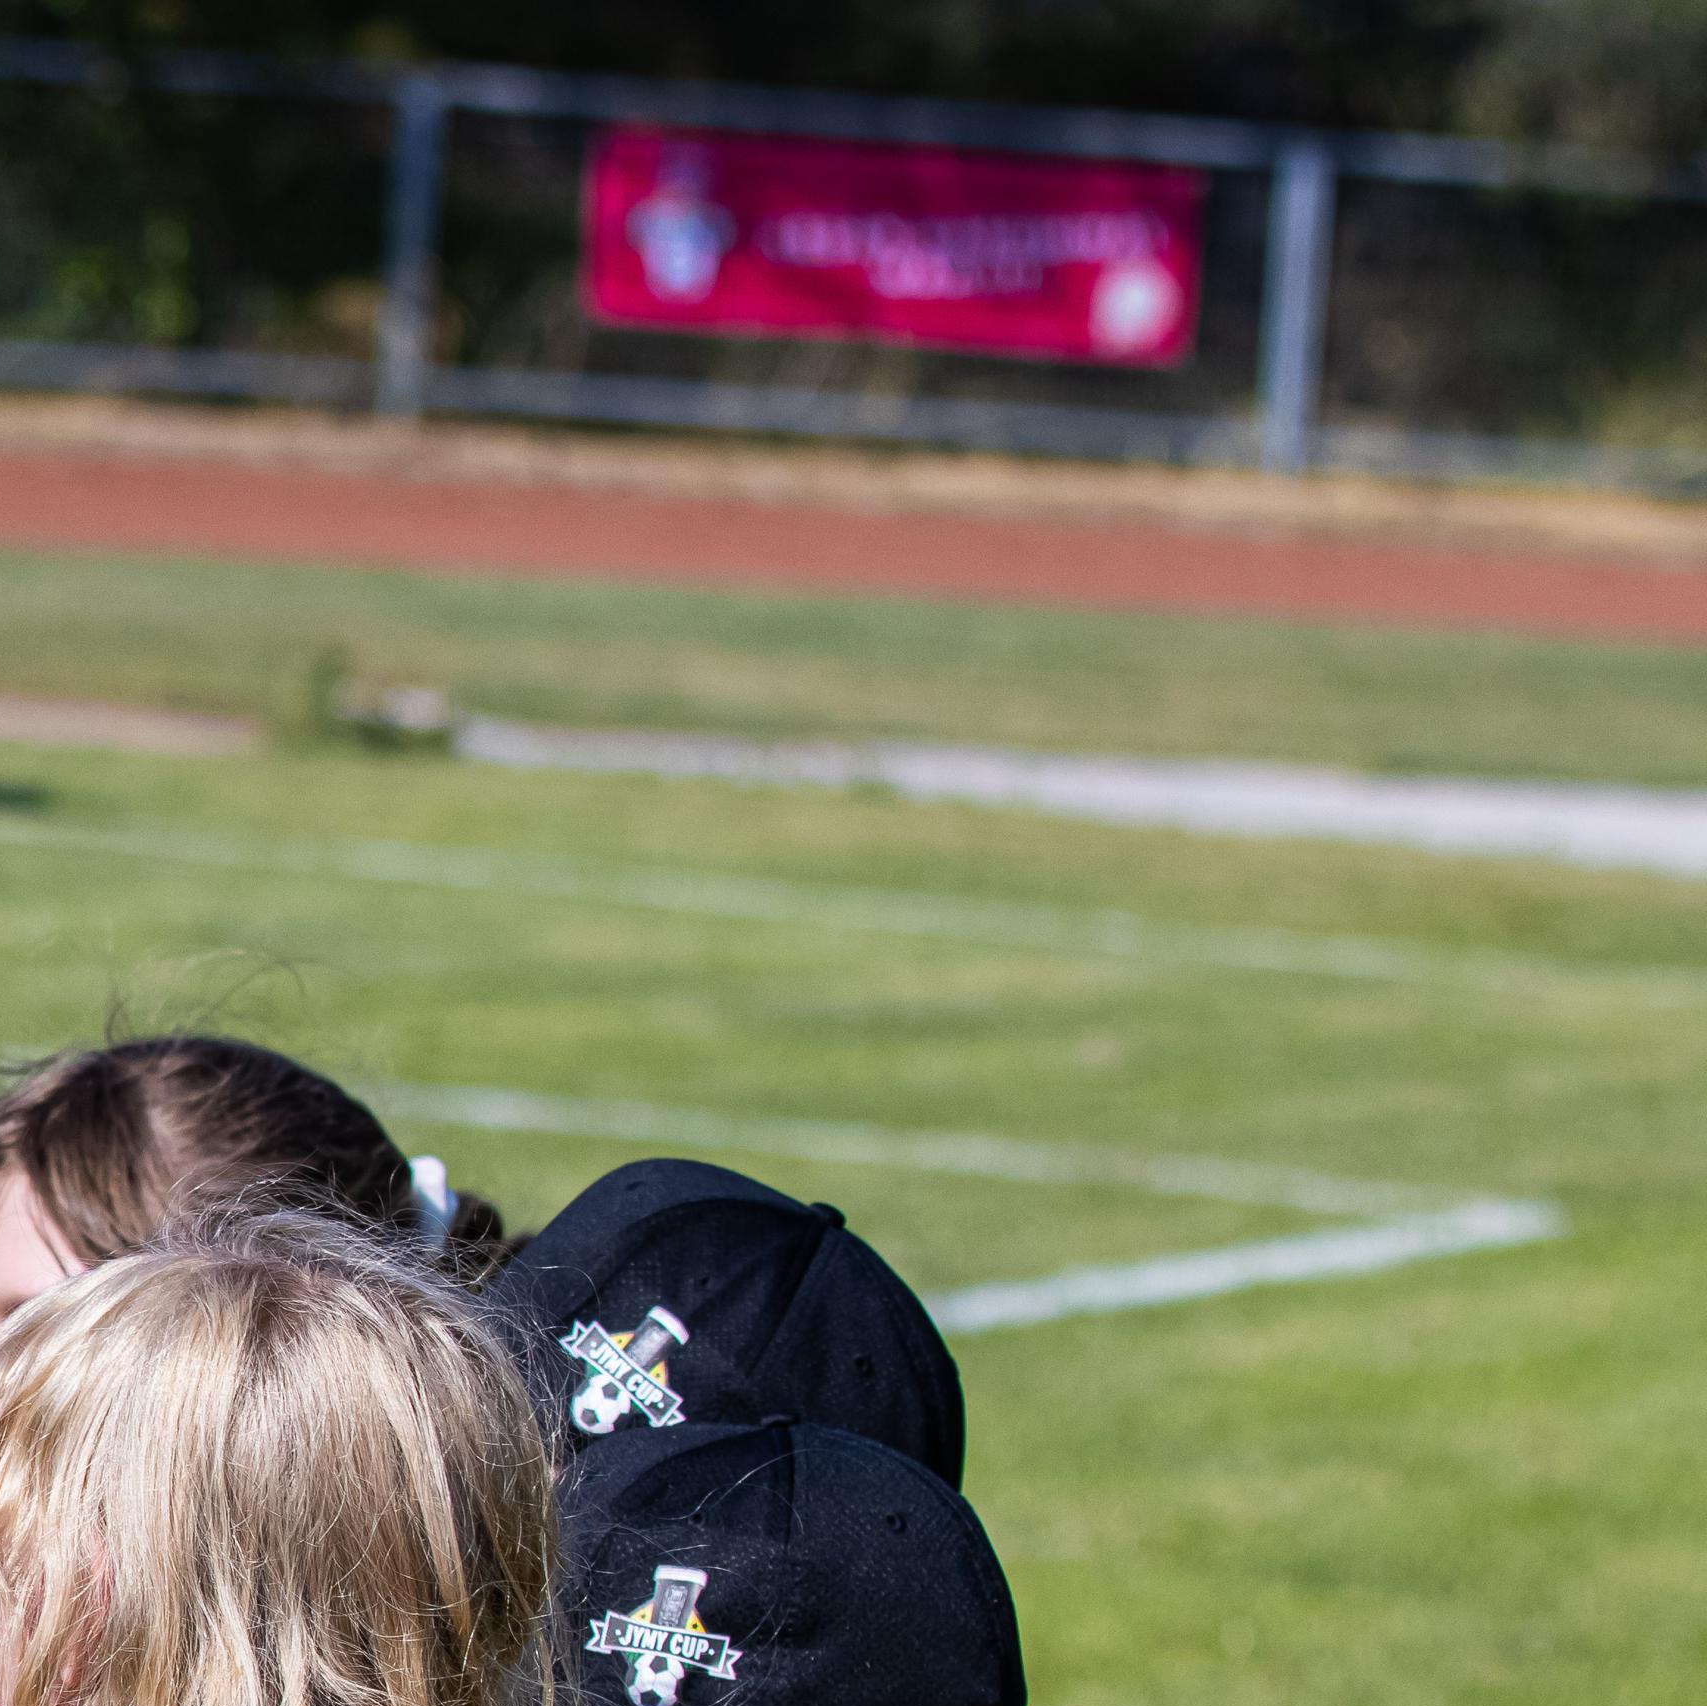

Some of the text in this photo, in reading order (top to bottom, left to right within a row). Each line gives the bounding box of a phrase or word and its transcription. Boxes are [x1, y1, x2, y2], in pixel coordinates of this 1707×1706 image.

[589, 1342, 664, 1406] JYMY CUP
[619, 1624, 709, 1660] JYMY CUP
